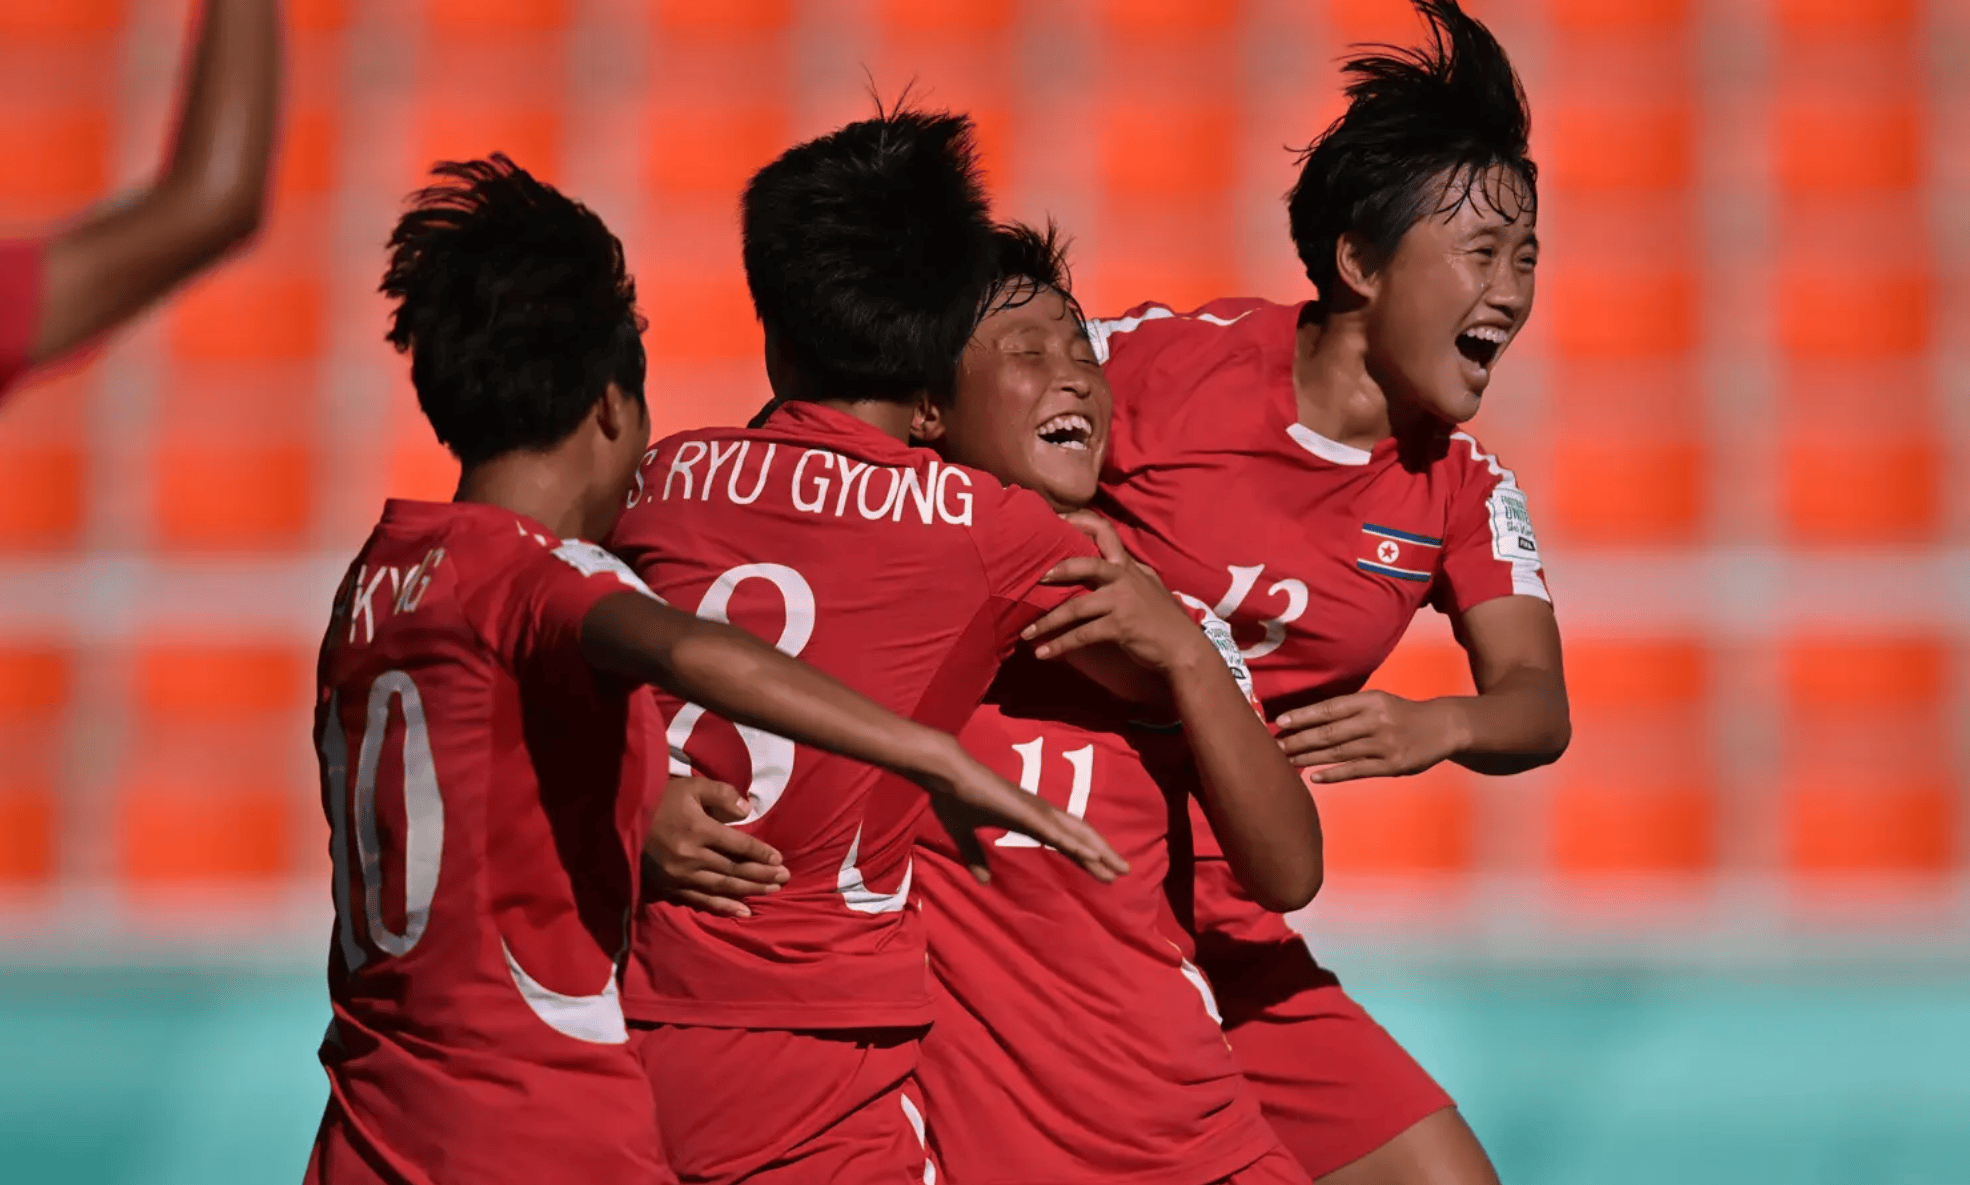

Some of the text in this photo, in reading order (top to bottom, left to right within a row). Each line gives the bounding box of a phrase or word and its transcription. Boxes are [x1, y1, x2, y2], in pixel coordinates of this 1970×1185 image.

[662, 440, 776, 505] RYU
[791, 448, 974, 527] GYONG
[1213, 563, 1309, 660] 13
[666, 563, 816, 826] 8
[321, 670, 445, 973] 10
[994, 736, 1094, 850] 11
